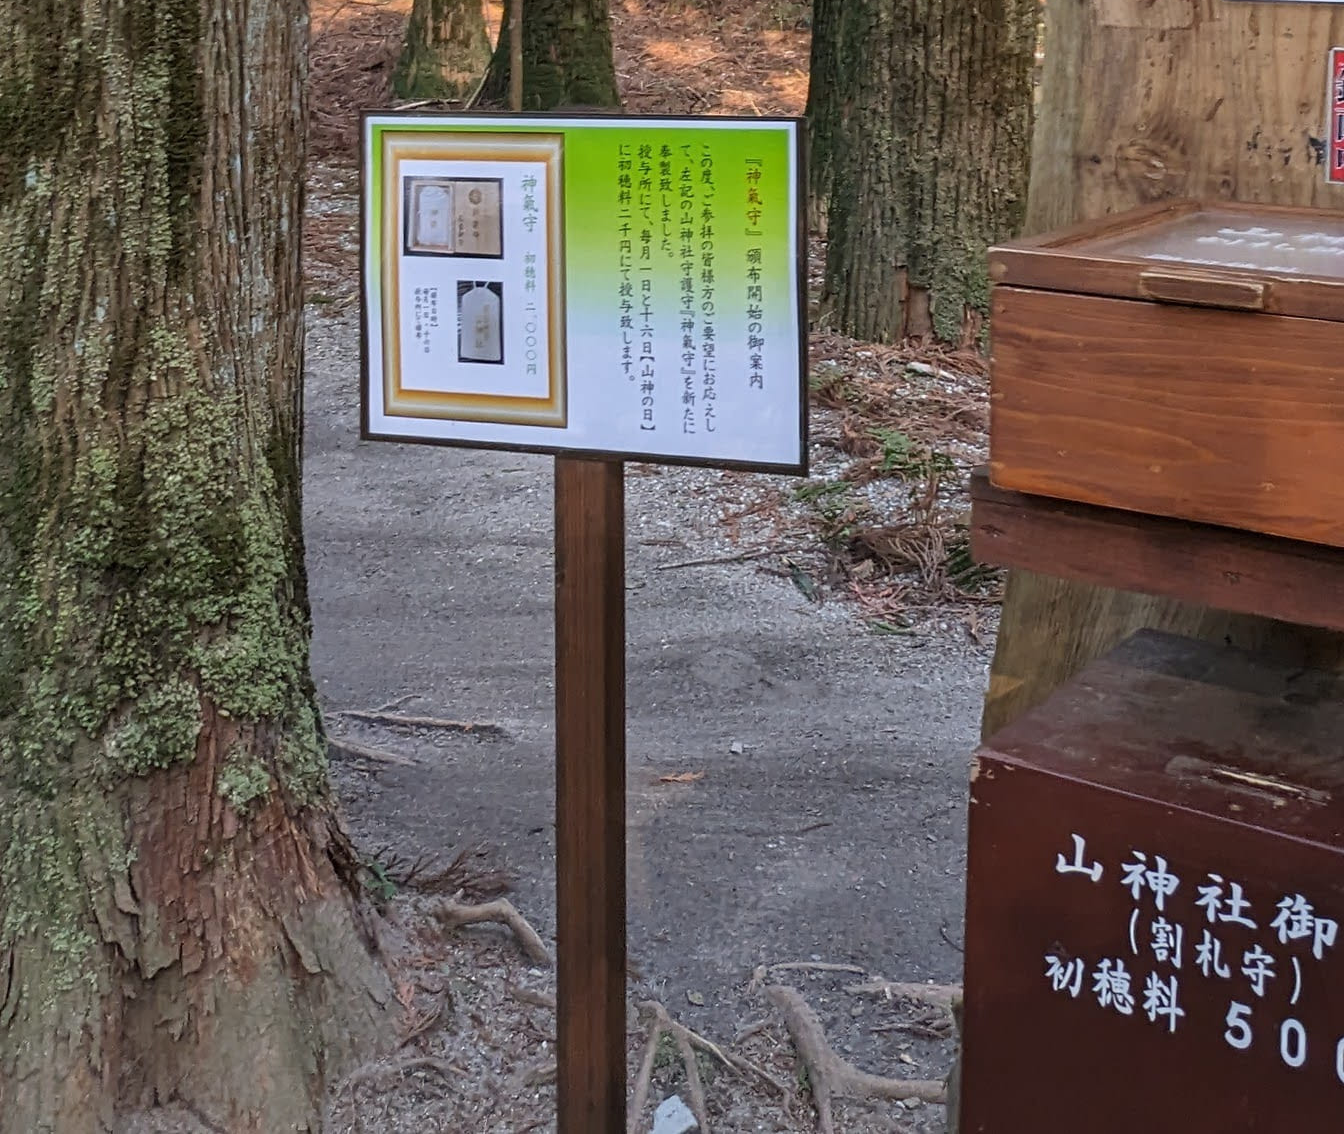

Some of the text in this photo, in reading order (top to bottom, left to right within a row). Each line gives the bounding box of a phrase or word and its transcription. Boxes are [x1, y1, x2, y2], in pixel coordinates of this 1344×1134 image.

[520, 175, 539, 233] 神氣守
[659, 144, 674, 258] 奉製致しました。
[524, 251, 537, 293] 初穂料
[618, 144, 635, 381] に初穂料二千円にて授与致します。
[637, 144, 656, 431] 授与所にて、毎月一日と十六日【山神の日】
[679, 144, 697, 434] て、左記の山神社守護守『神氣守』を新たに
[700, 145, 717, 432] この度、ご参拝の皆様方のご要望にお応えし
[1044, 953, 1185, 1032] 初穂料
[1128, 908, 1302, 1005] (割札守)
